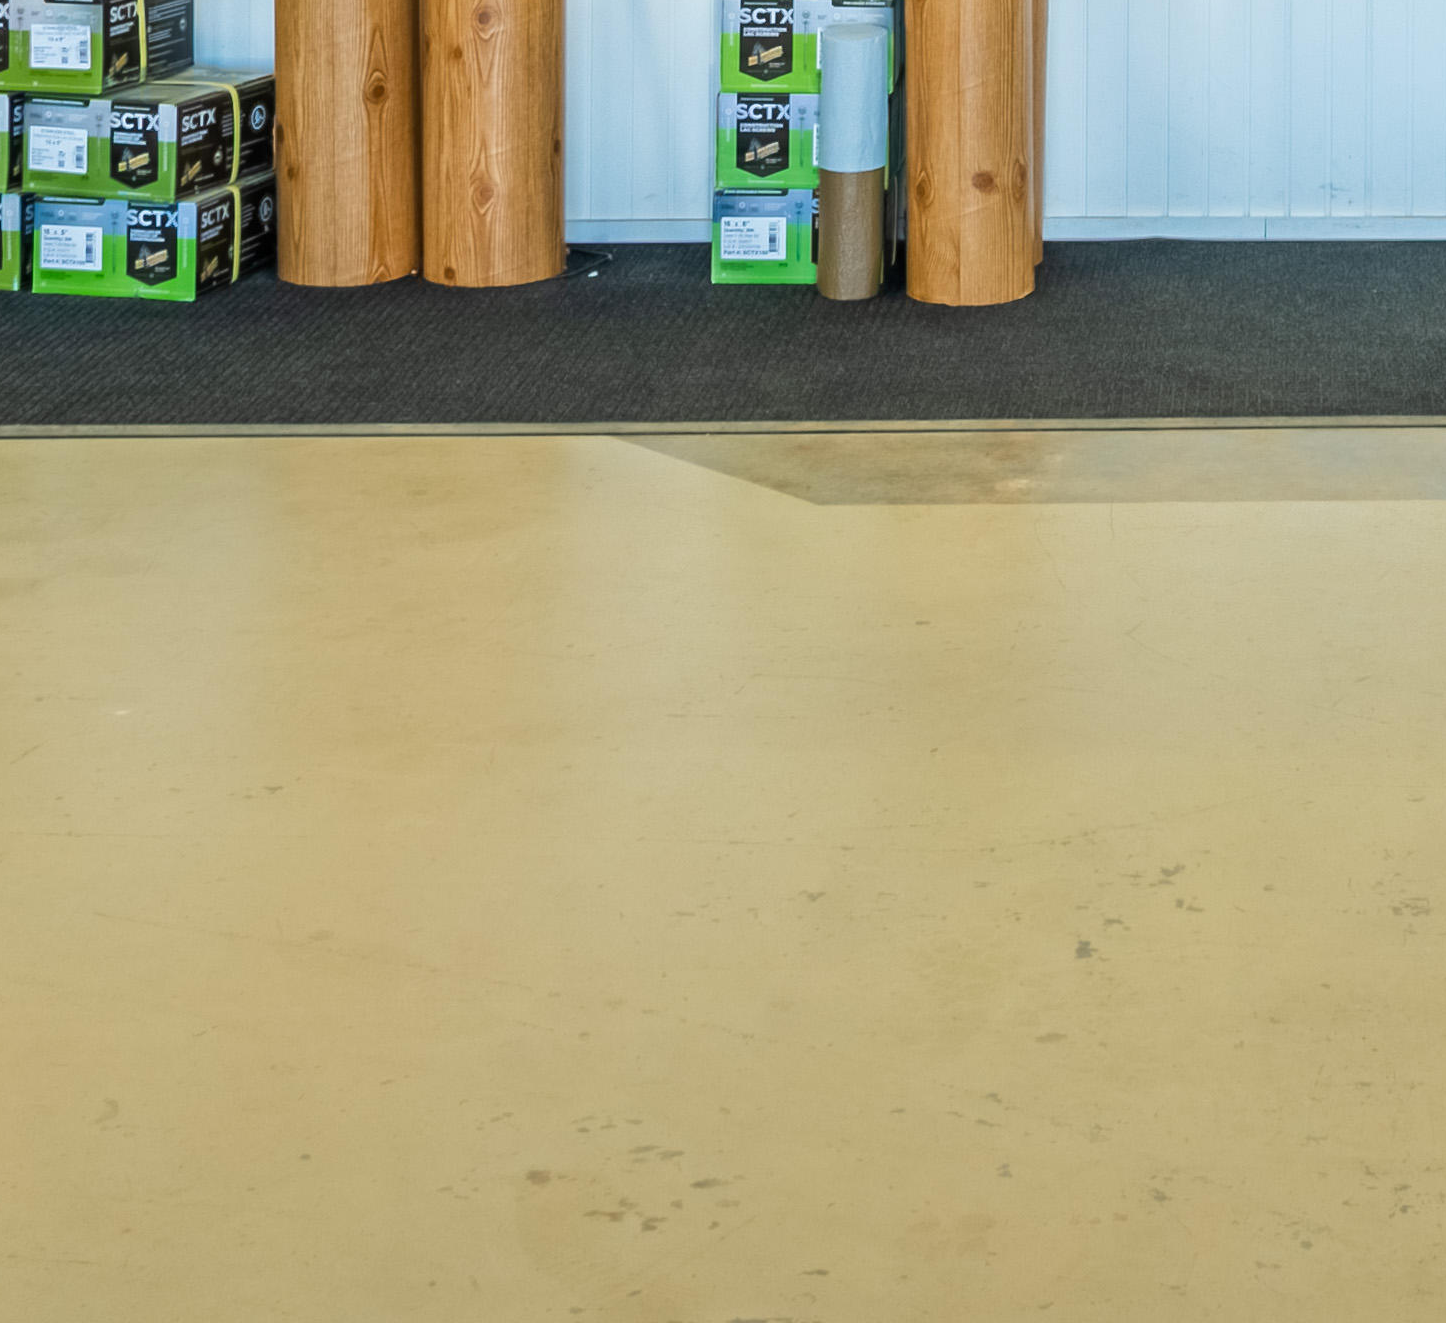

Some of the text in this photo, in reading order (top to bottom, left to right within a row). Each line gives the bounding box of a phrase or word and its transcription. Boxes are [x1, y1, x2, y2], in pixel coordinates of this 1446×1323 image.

[739, 7, 794, 25] SCTX
[181, 107, 217, 133] SCTX
[736, 103, 790, 121] SCTX
[109, 112, 160, 132] SCTX
[125, 209, 179, 228] SCTX
[200, 201, 230, 229] SCTX
